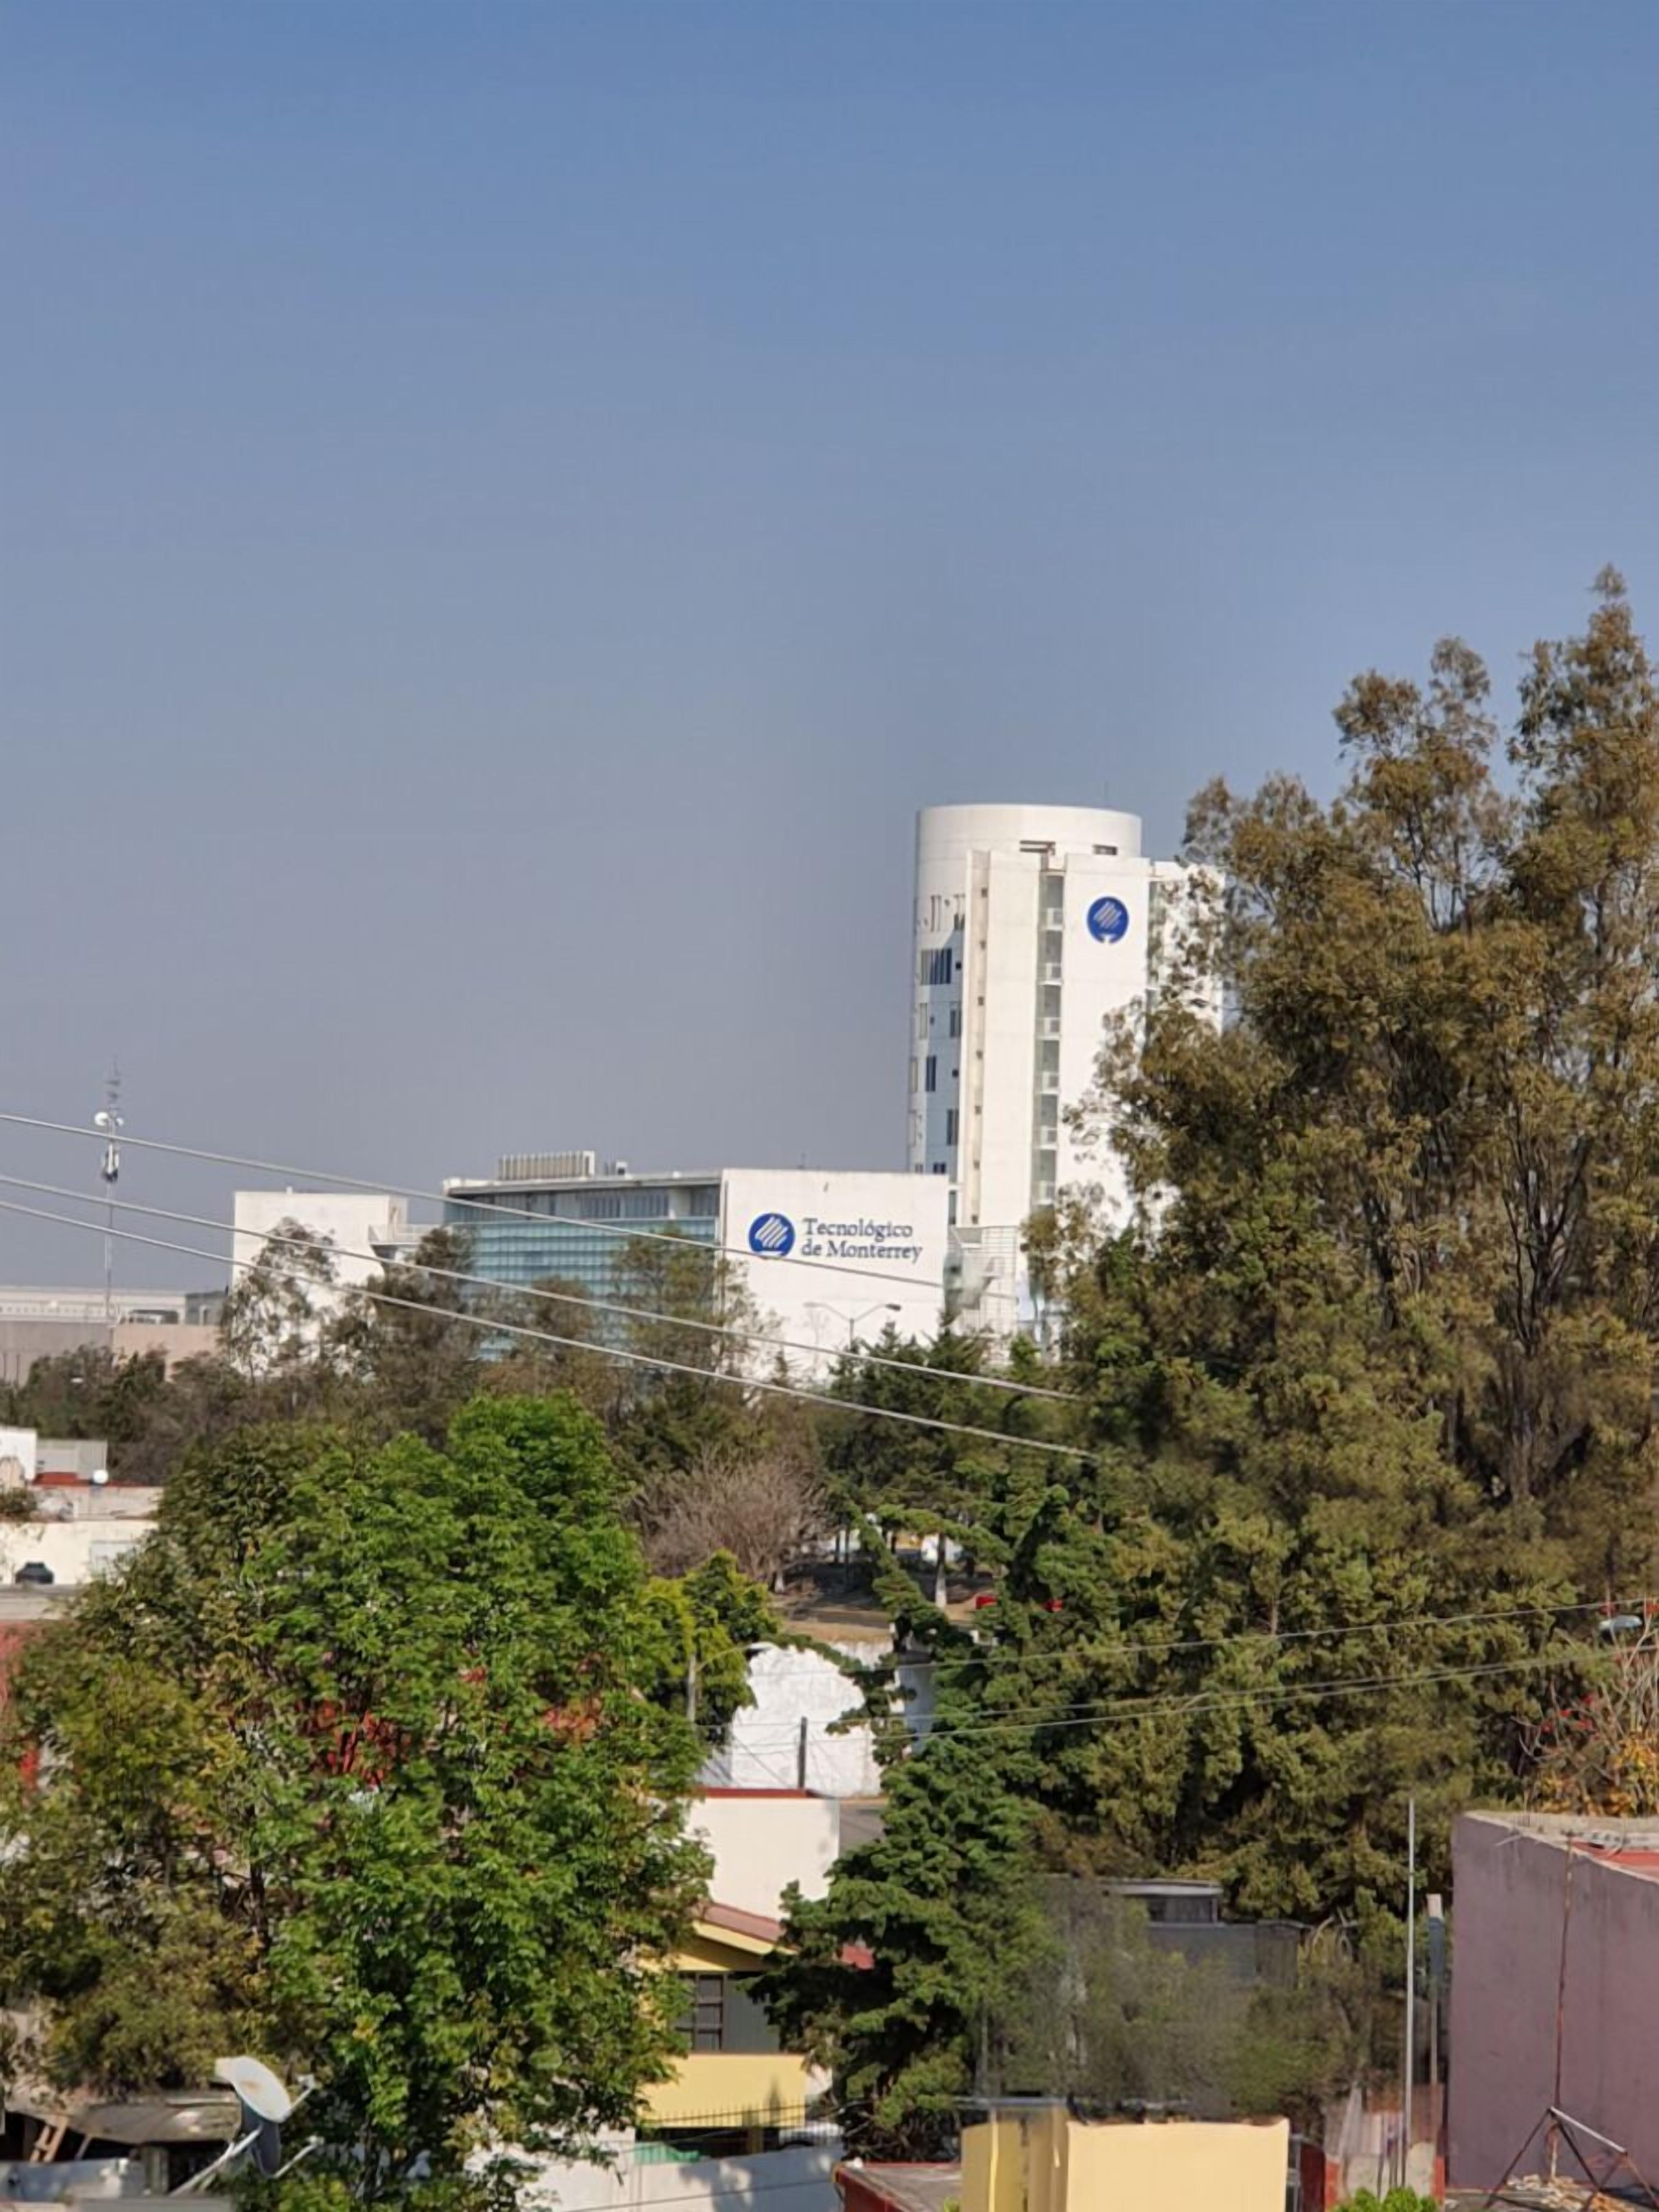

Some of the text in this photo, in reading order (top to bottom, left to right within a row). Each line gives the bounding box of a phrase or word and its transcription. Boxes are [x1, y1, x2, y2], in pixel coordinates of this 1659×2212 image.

[802, 1218, 913, 1242] Tecnológico
[801, 1238, 923, 1264] de Monterrey
